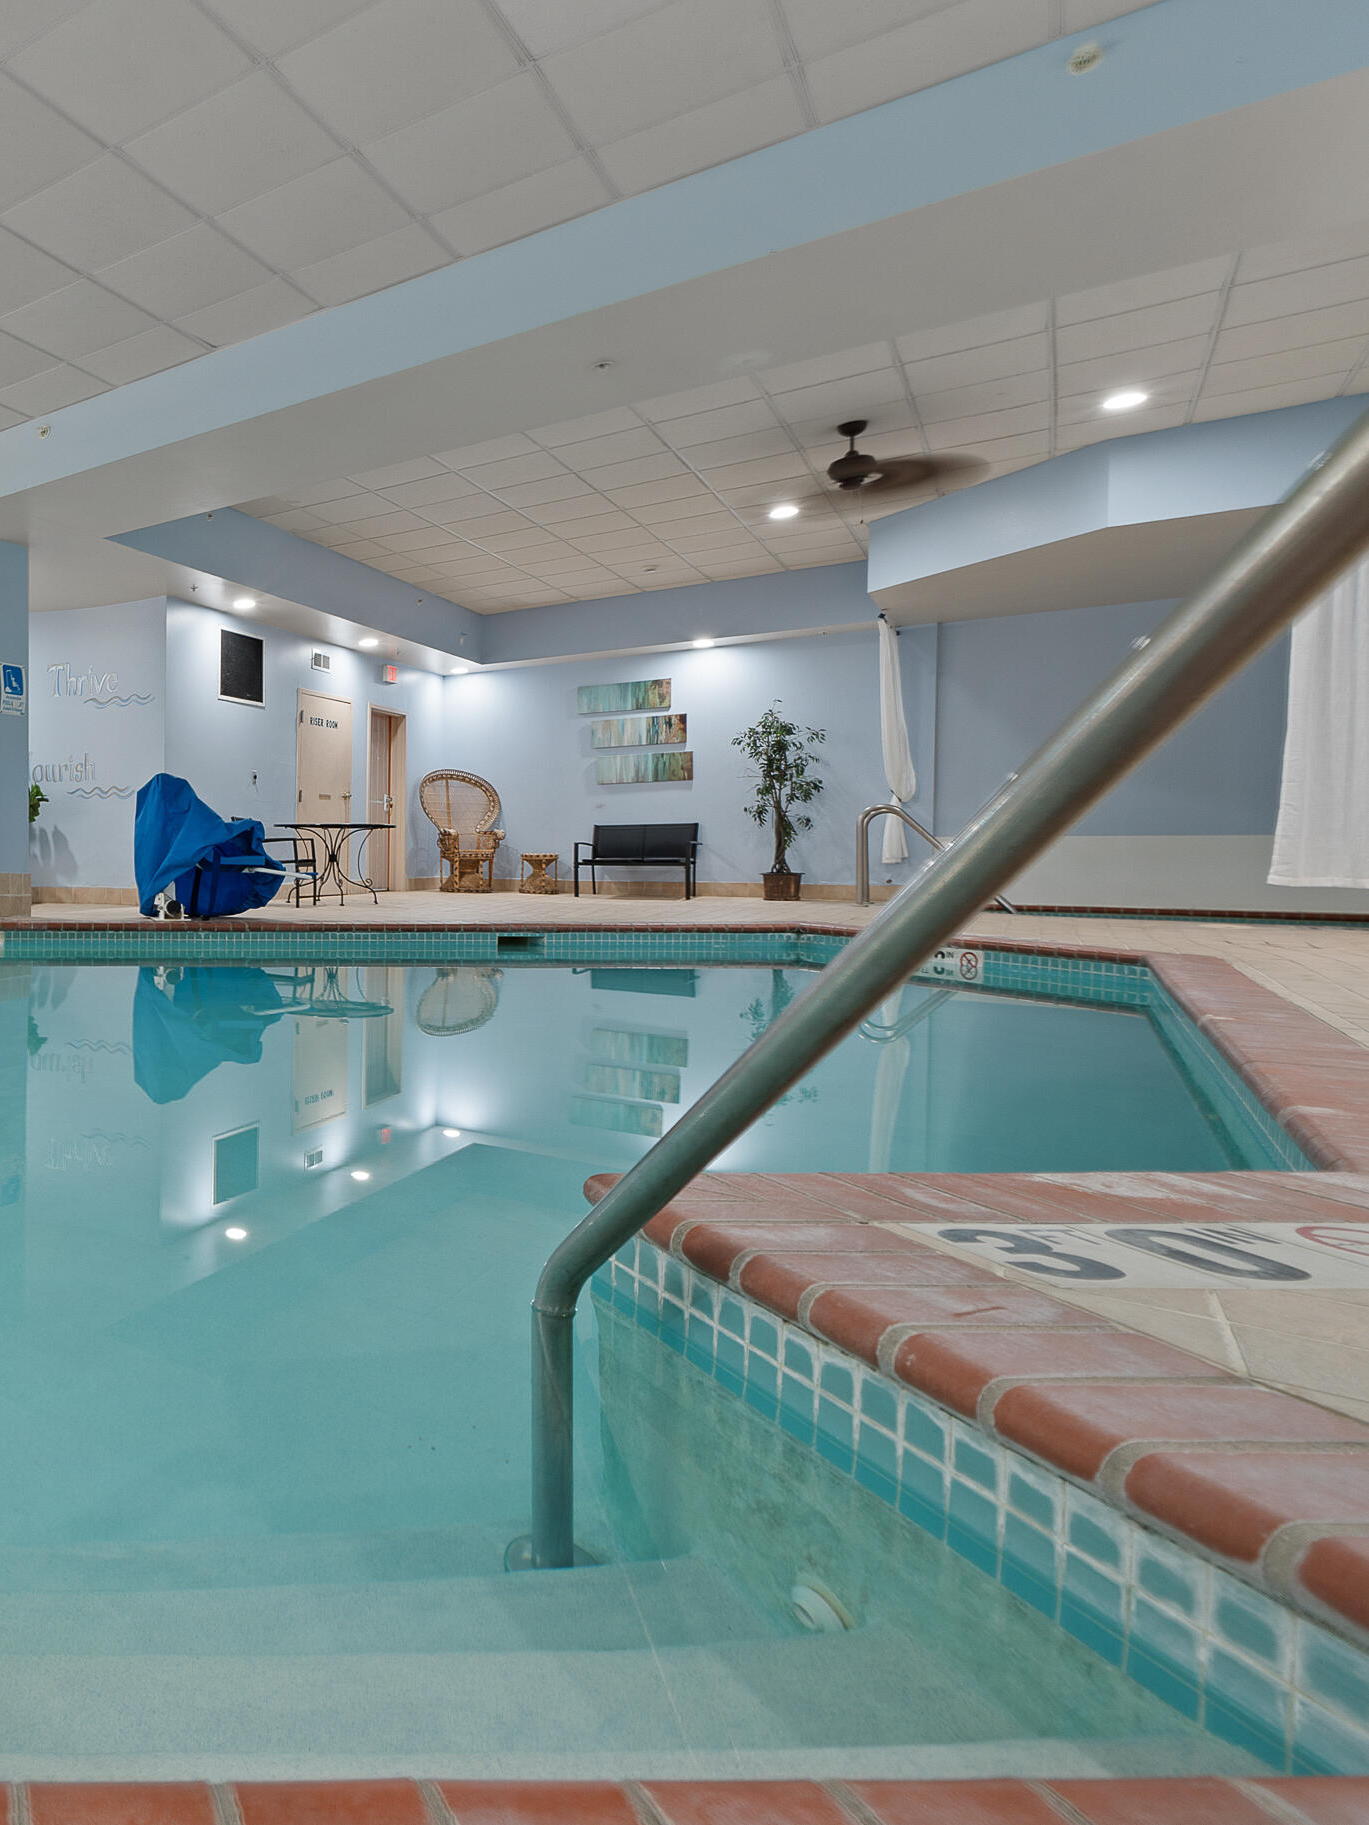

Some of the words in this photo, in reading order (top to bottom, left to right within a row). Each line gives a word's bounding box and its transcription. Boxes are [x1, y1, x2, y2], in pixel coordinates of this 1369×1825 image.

[47, 663, 119, 697] Thrive
[310, 716, 324, 727] RISER
[326, 719, 339, 729] ROOM
[31, 752, 96, 783] ourish
[1015, 1228, 1103, 1246] FT
[1183, 1227, 1283, 1246] IN
[937, 1228, 1127, 1281] 3
[1104, 1228, 1313, 1282] 0
